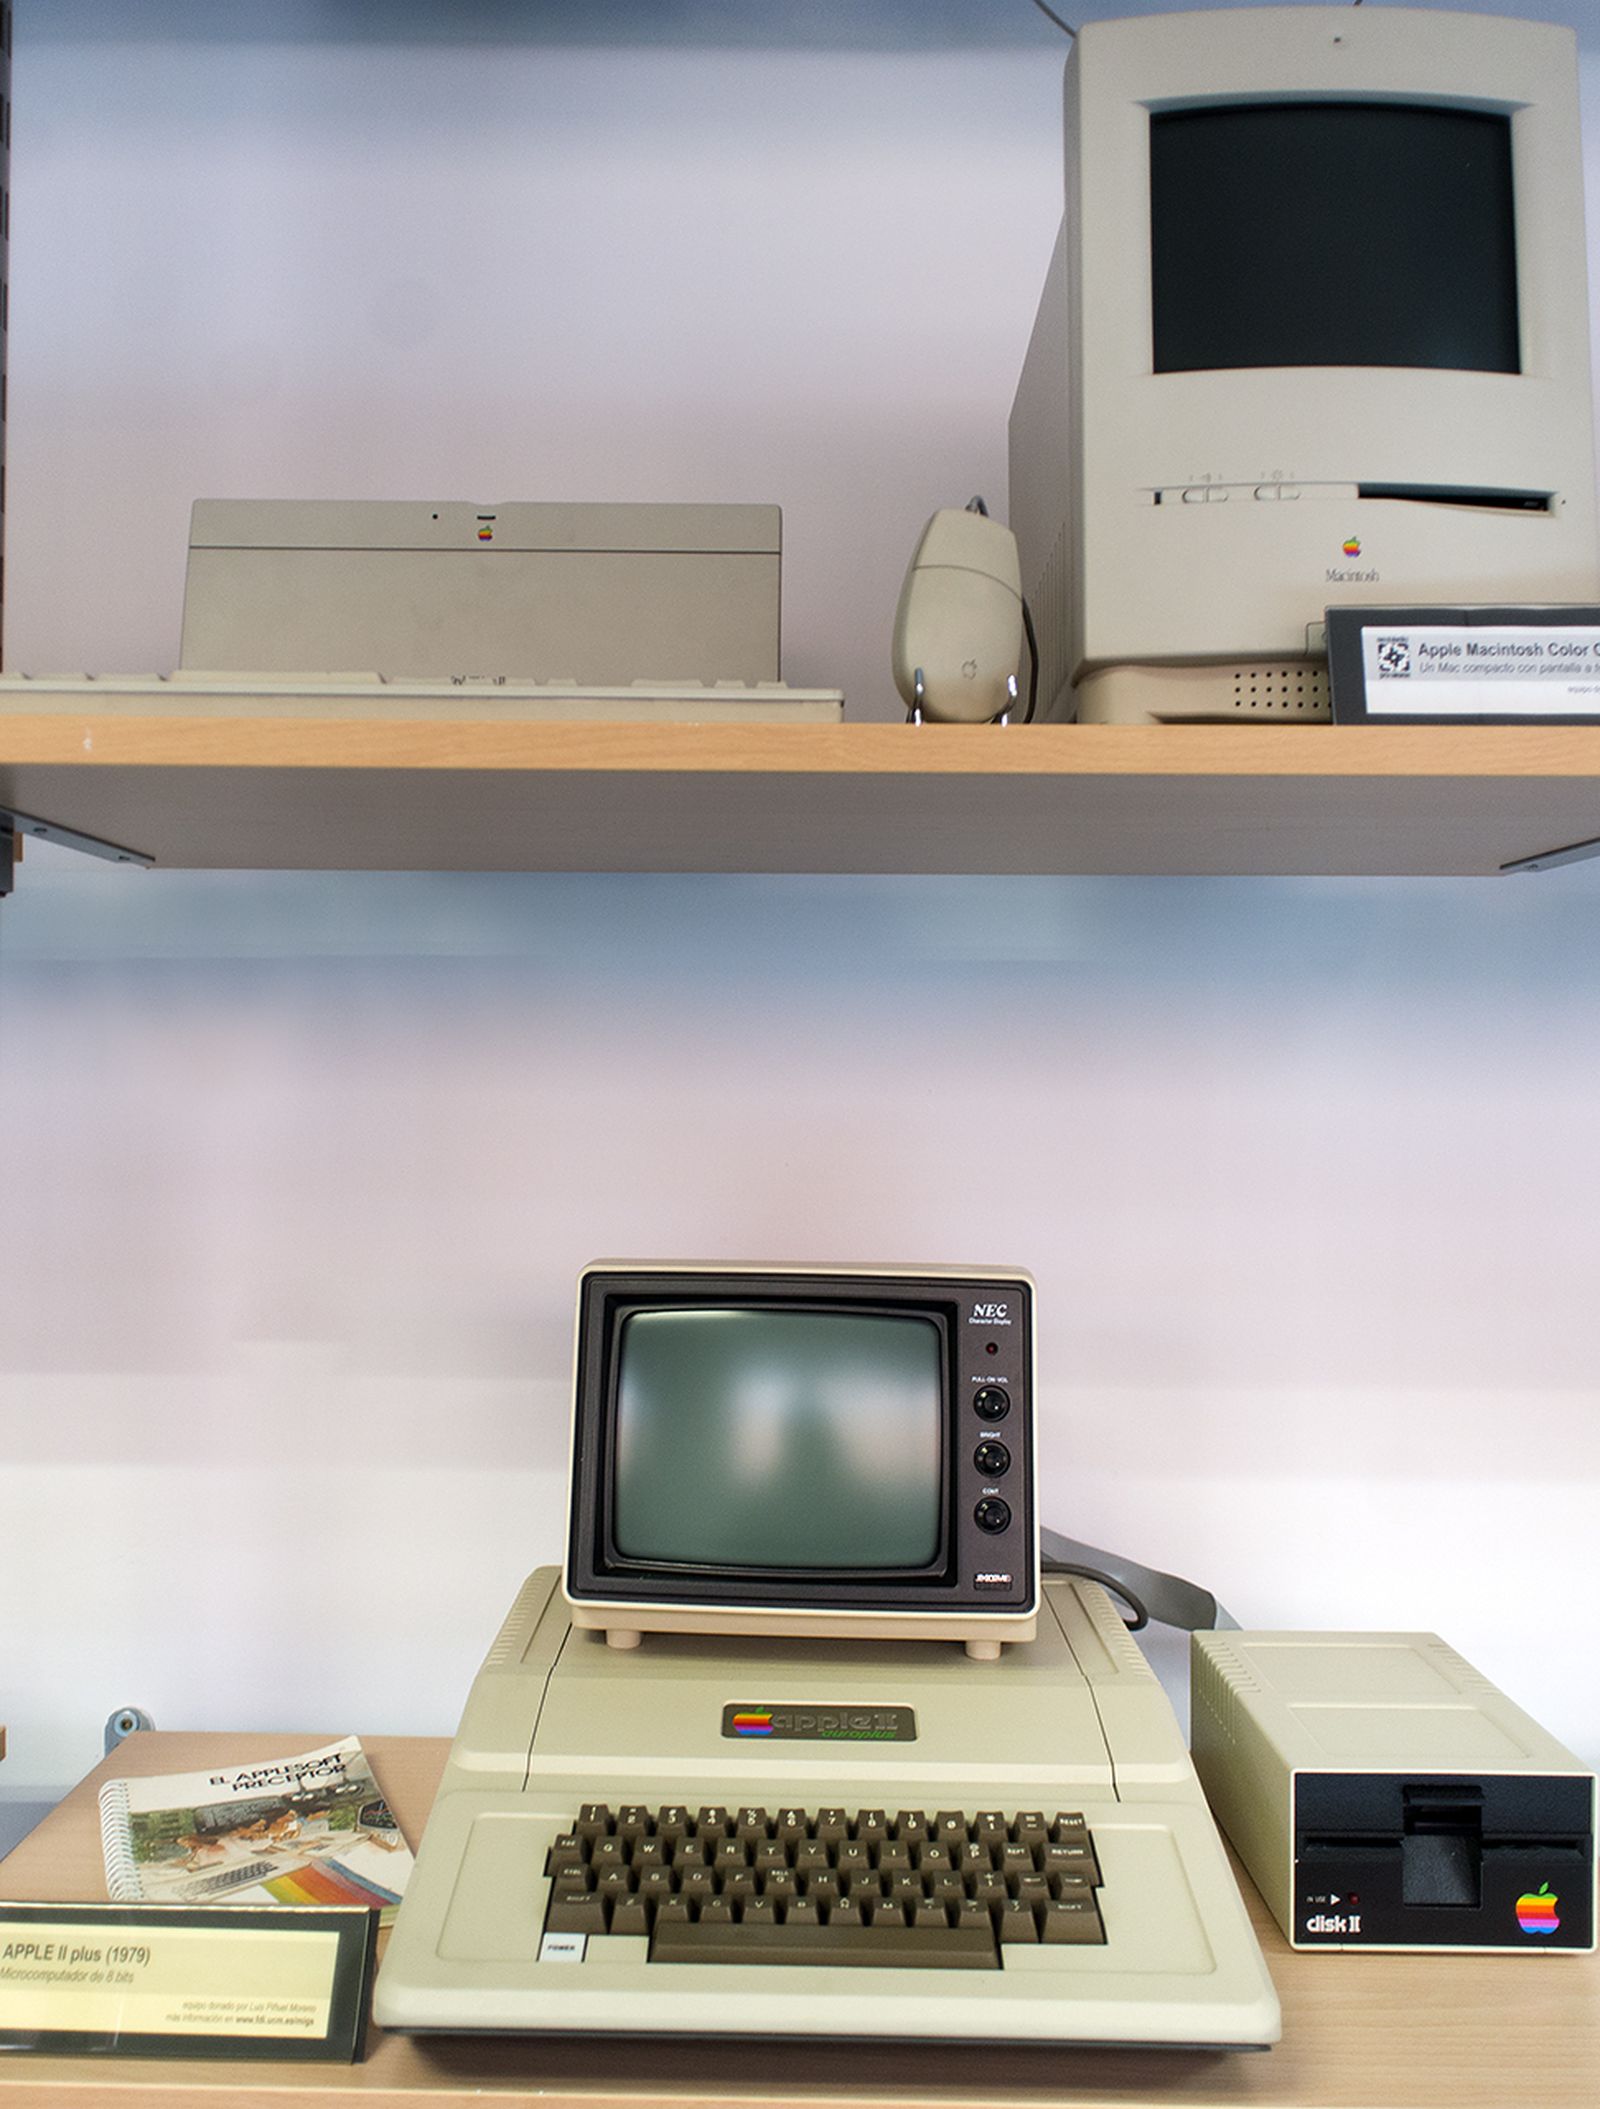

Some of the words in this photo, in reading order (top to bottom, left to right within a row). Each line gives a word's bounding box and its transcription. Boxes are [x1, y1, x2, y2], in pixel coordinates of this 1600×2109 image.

[1325, 568, 1380, 582] Macintosh
[1418, 642, 1462, 659] Apple
[1466, 642, 1544, 657] Macintosh
[1547, 642, 1589, 657] Color
[1419, 662, 1435, 673] Un
[1438, 662, 1461, 674] Mac
[1463, 662, 1515, 676] compacto
[1517, 664, 1537, 674] con
[1539, 662, 1582, 676] pantalla
[973, 1303, 1008, 1318] NEC
[993, 1318, 1012, 1326] Display
[996, 1376, 1009, 1384] VOL
[771, 1711, 871, 1732] apple
[209, 1776, 230, 1785] EL
[236, 1753, 342, 1783] APPLESOFT
[232, 1764, 347, 1792] PRECEPTOR
[1059, 1818, 1083, 1826] RESET
[643, 1844, 655, 1853] W
[848, 1848, 858, 1857] U
[930, 1849, 940, 1858] O
[1051, 1848, 1084, 1856] RETURN
[1314, 1895, 1326, 1903] USE
[1306, 1915, 1347, 1933] disk
[2, 1943, 55, 1960] APPLE
[57, 1945, 68, 1960] II
[69, 1945, 102, 1965] plus
[105, 1946, 151, 1967] (1979)
[0, 1967, 89, 1983] Microcomputador
[90, 1970, 104, 1982] de
[105, 1970, 114, 1983] 8
[115, 1971, 135, 1984] bits
[182, 2001, 206, 2012] equipo
[235, 2003, 248, 2012] por
